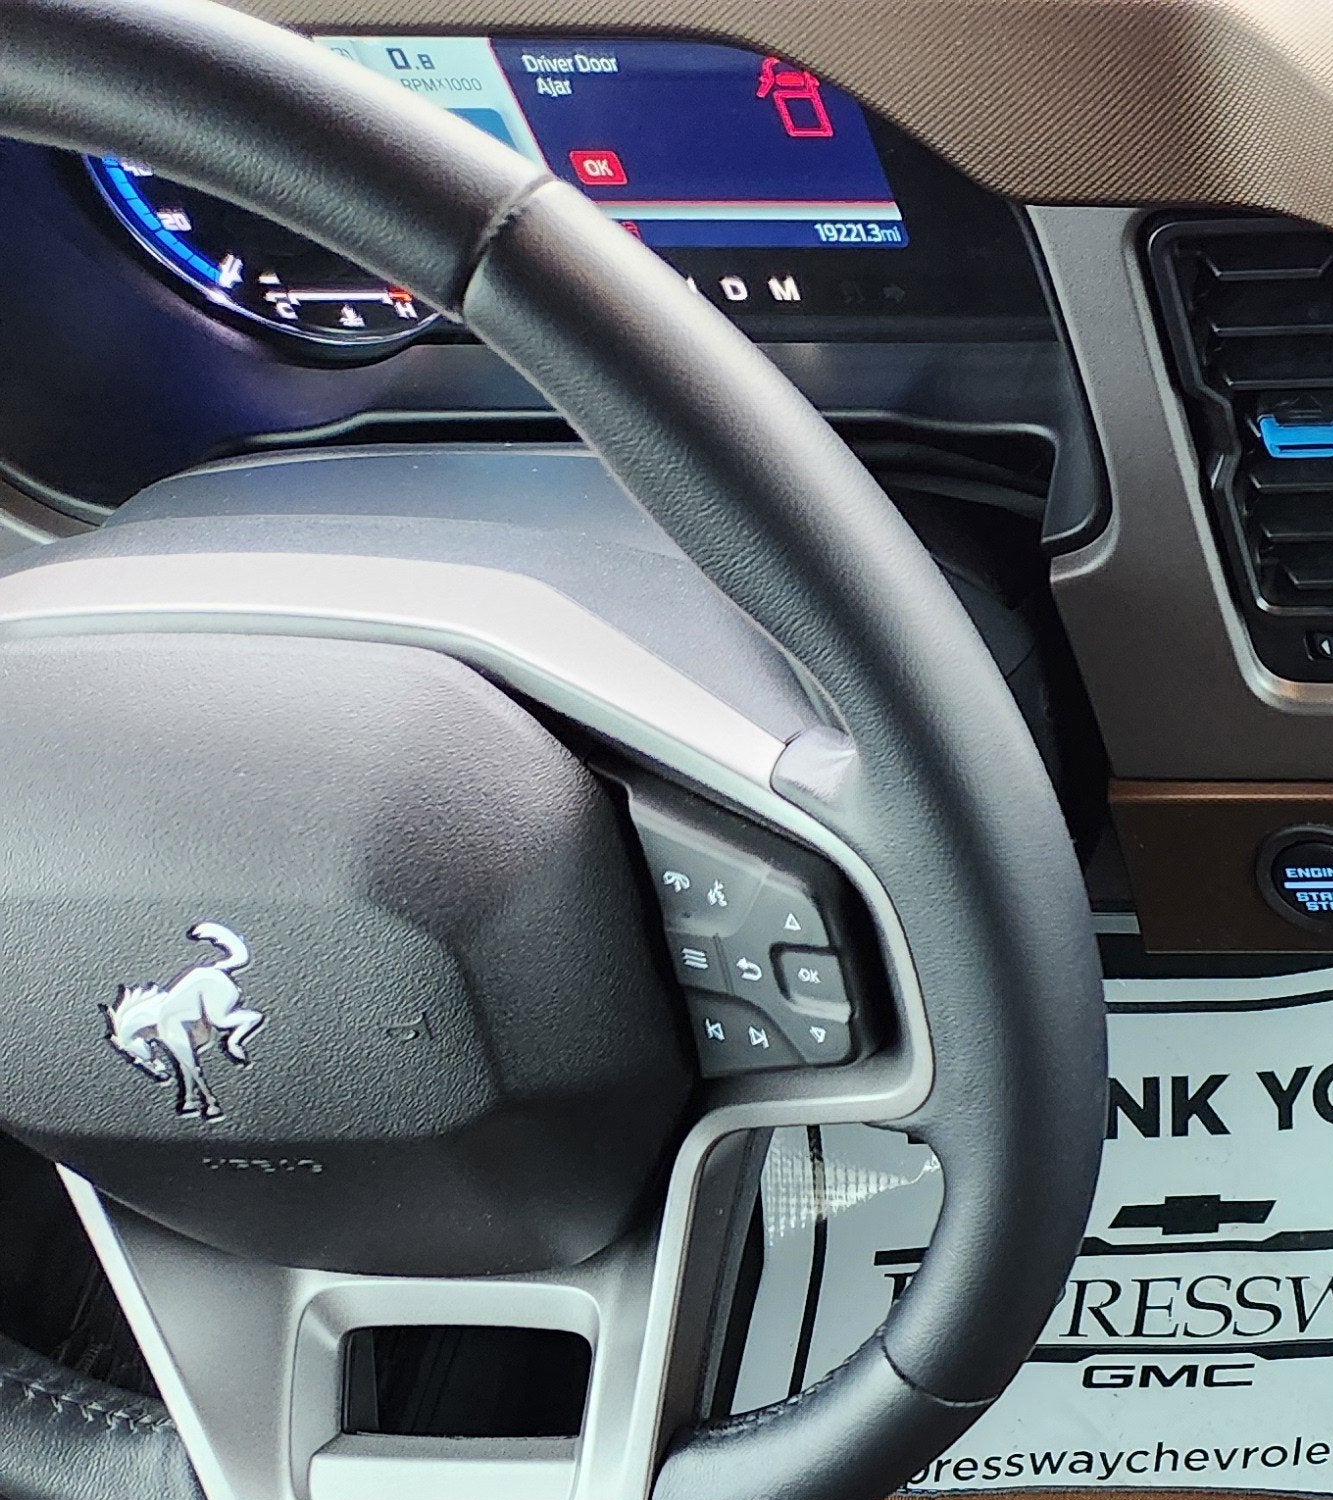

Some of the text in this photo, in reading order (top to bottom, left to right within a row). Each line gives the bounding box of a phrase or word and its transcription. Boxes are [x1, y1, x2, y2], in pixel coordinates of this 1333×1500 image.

[521, 53, 619, 73] Driver Door
[537, 76, 573, 97] Ajar
[583, 159, 614, 177] OK
[720, 274, 801, 300] D M
[798, 967, 822, 984] OK
[1081, 1362, 1256, 1391] GMC
